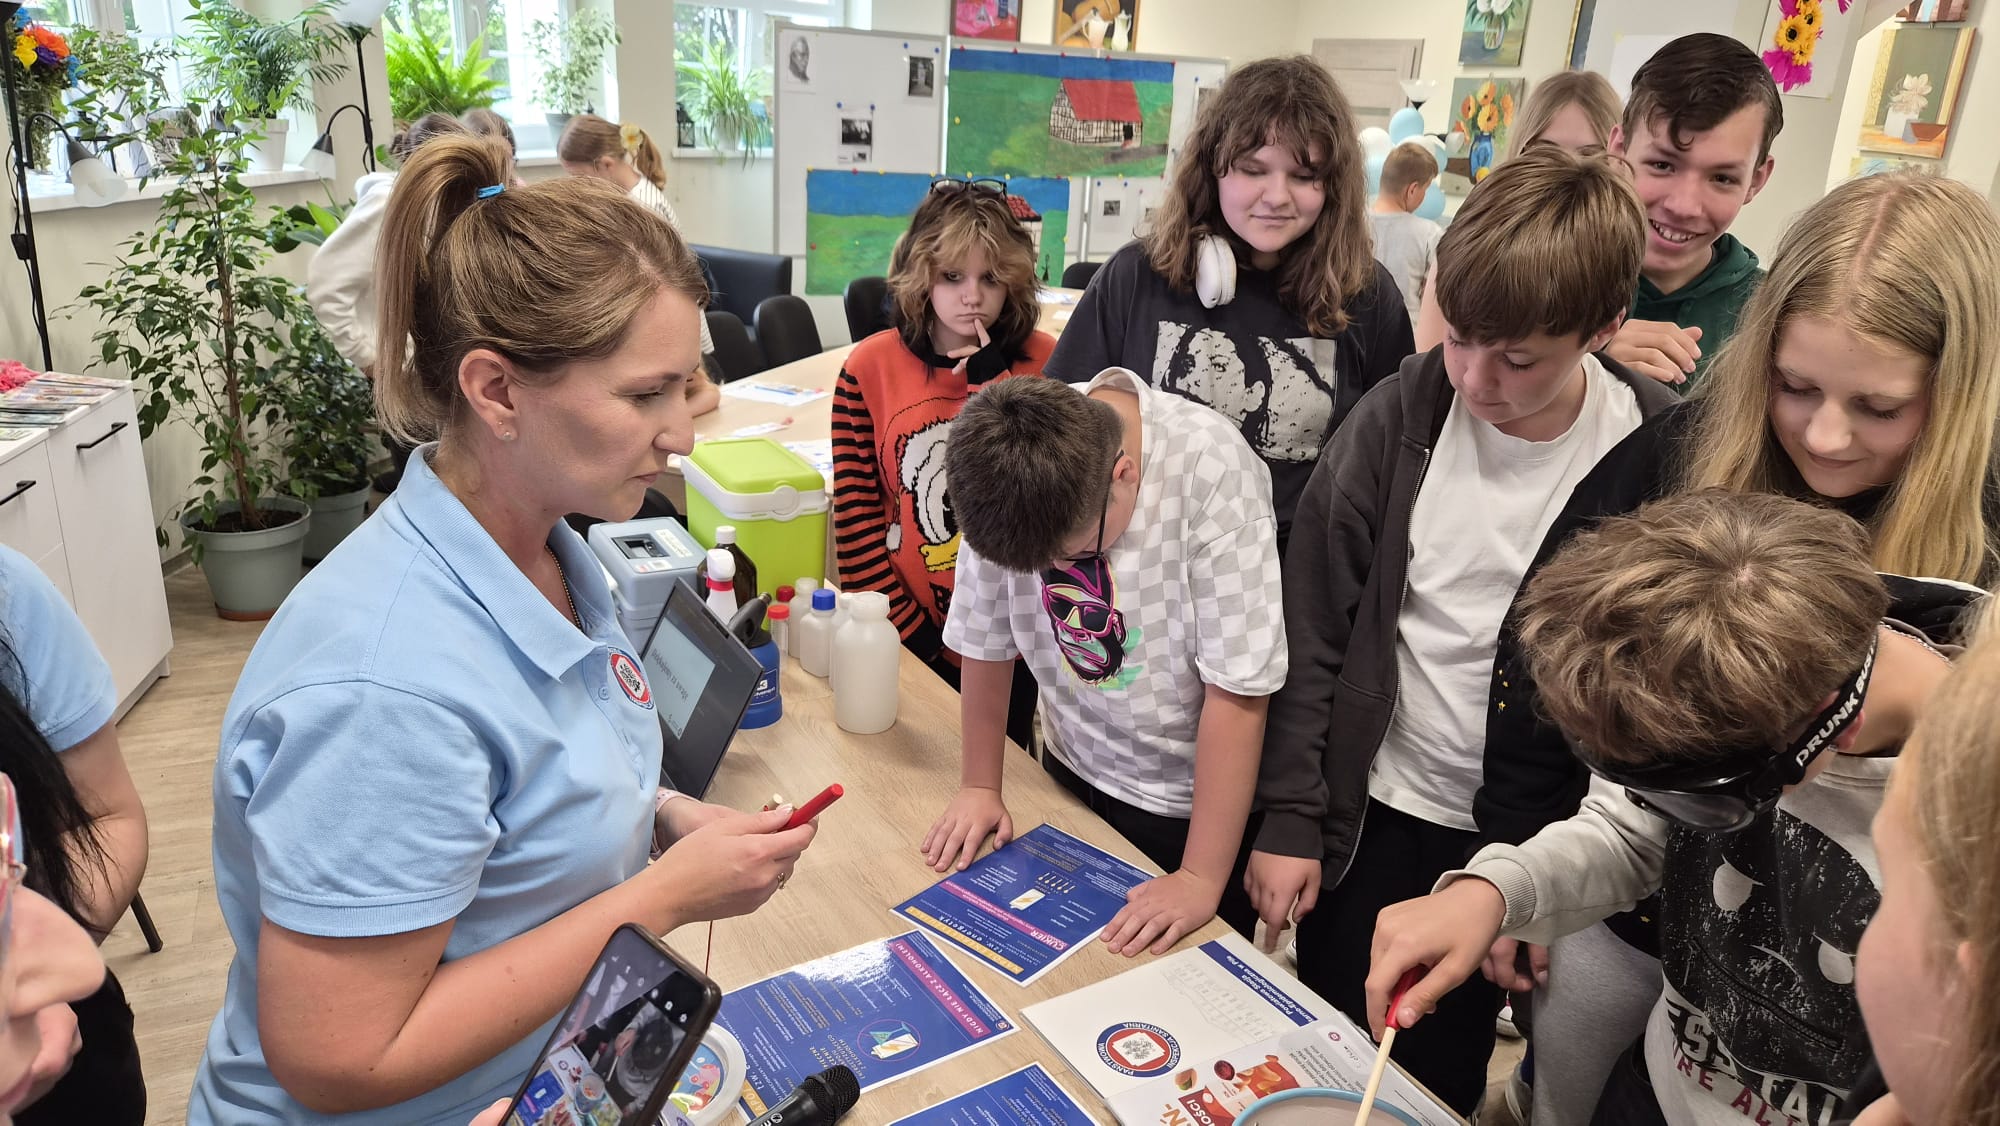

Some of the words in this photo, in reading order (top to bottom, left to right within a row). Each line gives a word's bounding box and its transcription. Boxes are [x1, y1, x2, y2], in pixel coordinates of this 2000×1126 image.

[1796, 692, 1859, 767] DRUNK
[1027, 929, 1066, 951] CUKIER
[892, 941, 935, 979] ALKOHOLEM!
[932, 982, 955, 1001] ŁĄCZ
[1239, 972, 1261, 991] Stacja
[1242, 966, 1314, 1022] tarno-Epidemiologiczna
[1258, 987, 1293, 1016] Powiatowa
[949, 999, 965, 1013] NIE
[960, 1012, 985, 1034] NIGDY
[744, 1070, 767, 1090] tzw.
